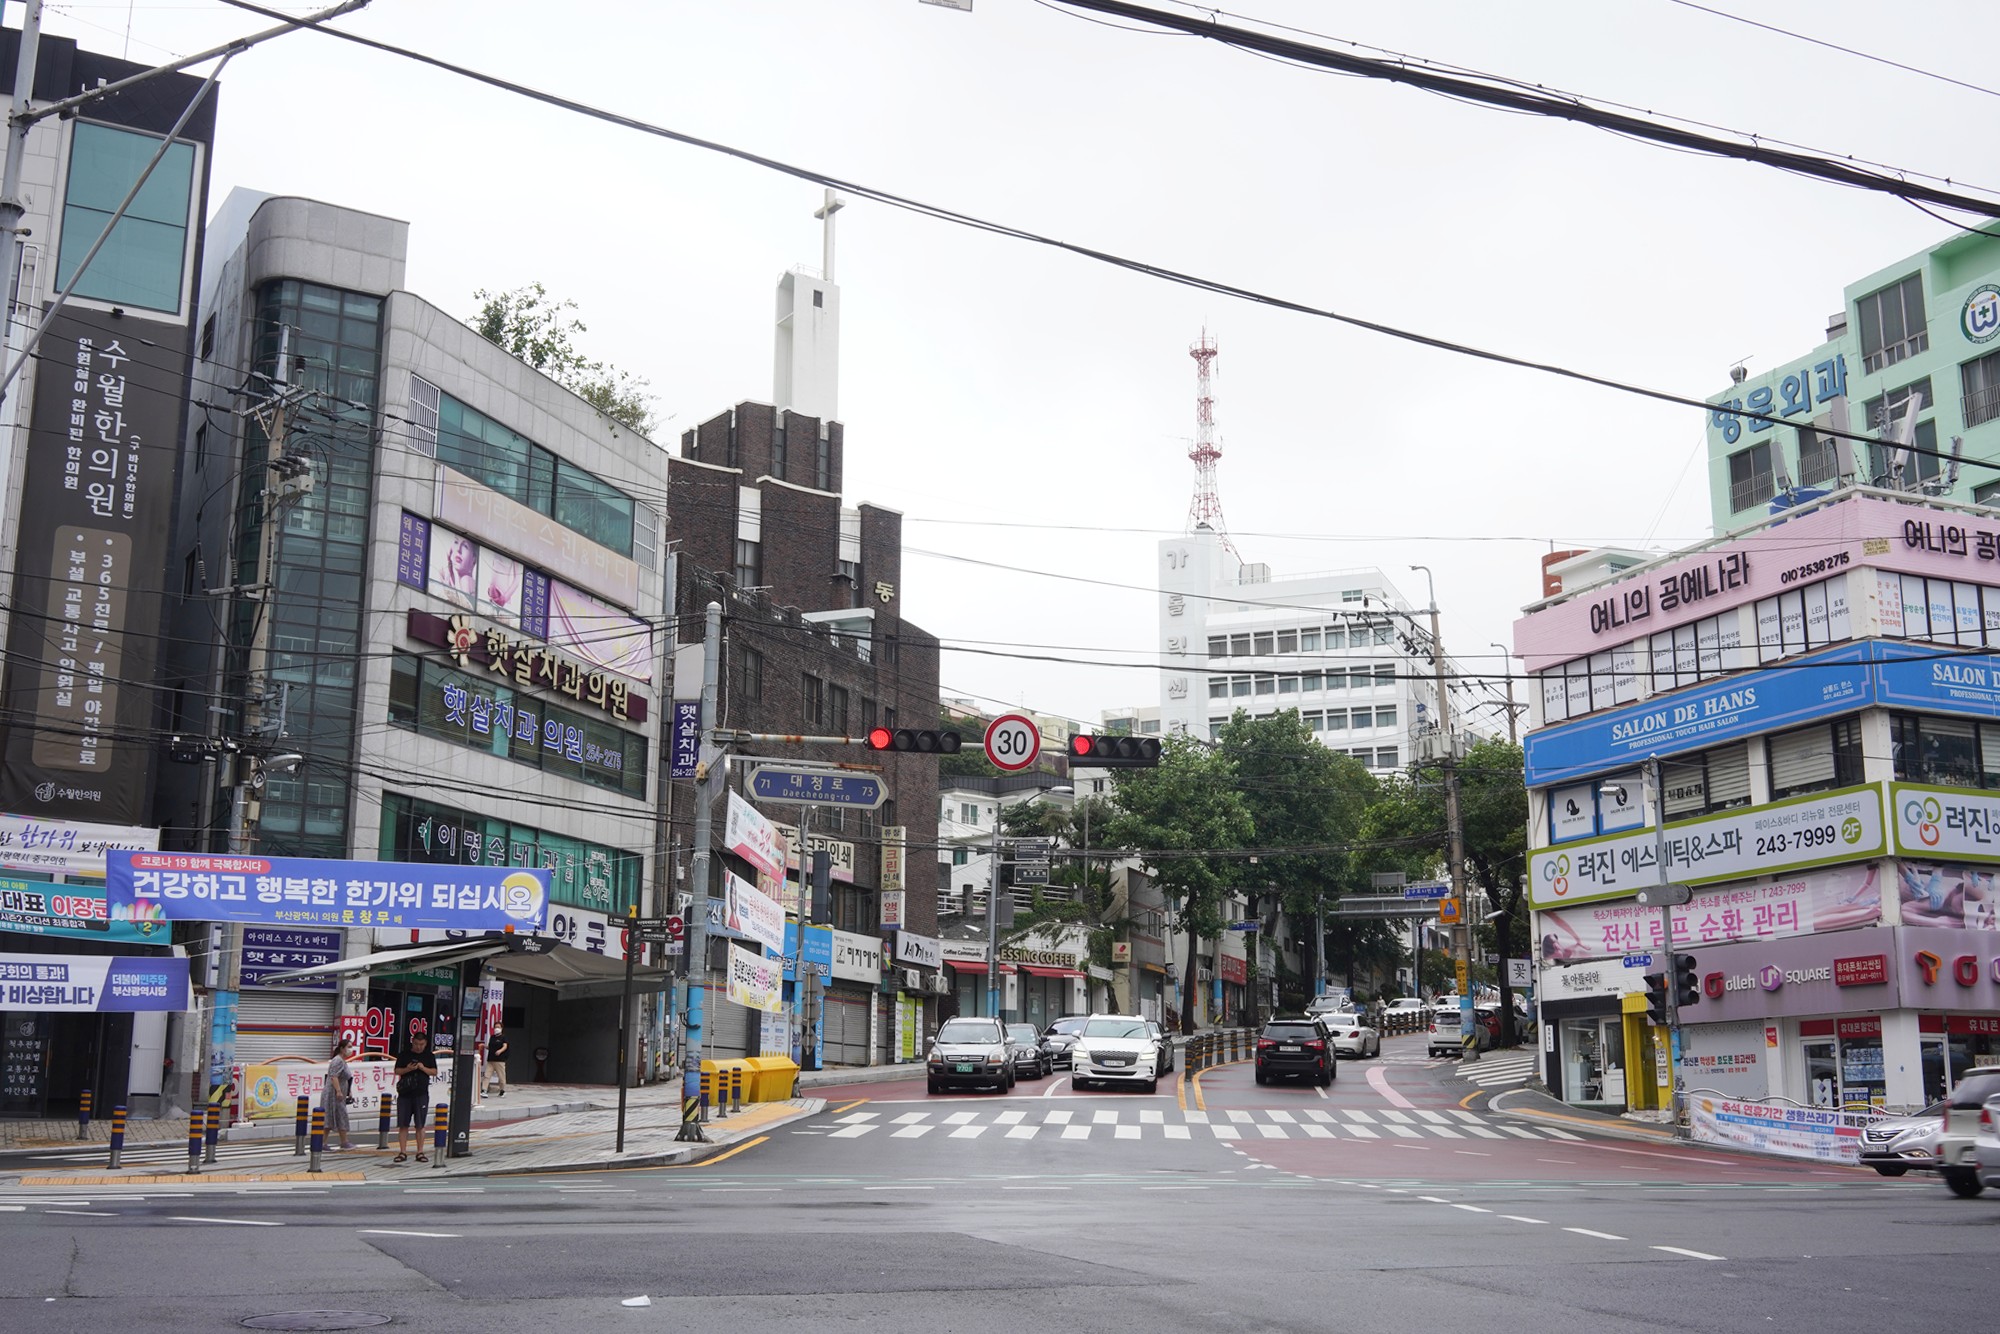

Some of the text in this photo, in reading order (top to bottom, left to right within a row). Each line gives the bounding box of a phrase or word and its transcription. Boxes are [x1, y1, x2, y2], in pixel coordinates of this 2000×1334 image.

[69, 399, 87, 441] 완비된
[86, 340, 130, 516] 수월한의원
[65, 446, 82, 490] 한의원
[1904, 519, 1967, 556] 여니의
[69, 550, 86, 581] 부설
[875, 581, 895, 602] 동
[1590, 551, 1750, 634] 여니의 공예나라
[487, 628, 628, 722] 햇살치과의원
[1933, 663, 1985, 686] SALON
[443, 683, 538, 745] 햇살치과
[543, 719, 583, 763] 의원
[1612, 687, 1756, 741] SALON DE HANS
[679, 705, 698, 766] 햇살치과
[997, 730, 1027, 755] 30
[1629, 731, 1675, 750] PROFESSIONAL
[1716, 714, 1740, 727] SALON
[761, 775, 873, 797] 71 대청로 73
[783, 788, 850, 802] Daecheong-ro
[1828, 801, 1861, 818] 전문센터
[20, 824, 77, 851] 한가위
[1946, 806, 1991, 844] 려진
[141, 856, 262, 872] 코로나 19 함께 극복합시다
[1578, 849, 1617, 888] 려진
[1756, 825, 1836, 857] 243-7999
[1843, 823, 1860, 840] 2F
[133, 871, 532, 911] 건강하고 행복한 한가위 되십시오
[1768, 882, 1807, 898] 243-7999
[275, 910, 319, 921] 부산광역시
[322, 911, 338, 921] 의원
[1602, 920, 1640, 952] 전신
[1699, 908, 1744, 941] 순환
[1753, 899, 1799, 936] 관리
[248, 932, 282, 943] 아이리스
[285, 935, 302, 946] 스킨
[312, 936, 328, 946] 바디
[247, 951, 329, 964] 햇살치과
[1039, 951, 1076, 966] COFFEE
[1836, 959, 1882, 973] 휴대폰최고싼집
[36, 966, 65, 980] 통과!
[113, 974, 167, 986] 더불어민주당
[1726, 967, 1831, 992] olleh SQUARE
[9, 985, 94, 1005] 비상합니다
[113, 985, 167, 997] 부산광역시당
[287, 1073, 324, 1097] 즐겁고
[1722, 1101, 1840, 1126] 추석 연휴기간 생활쓰레기
